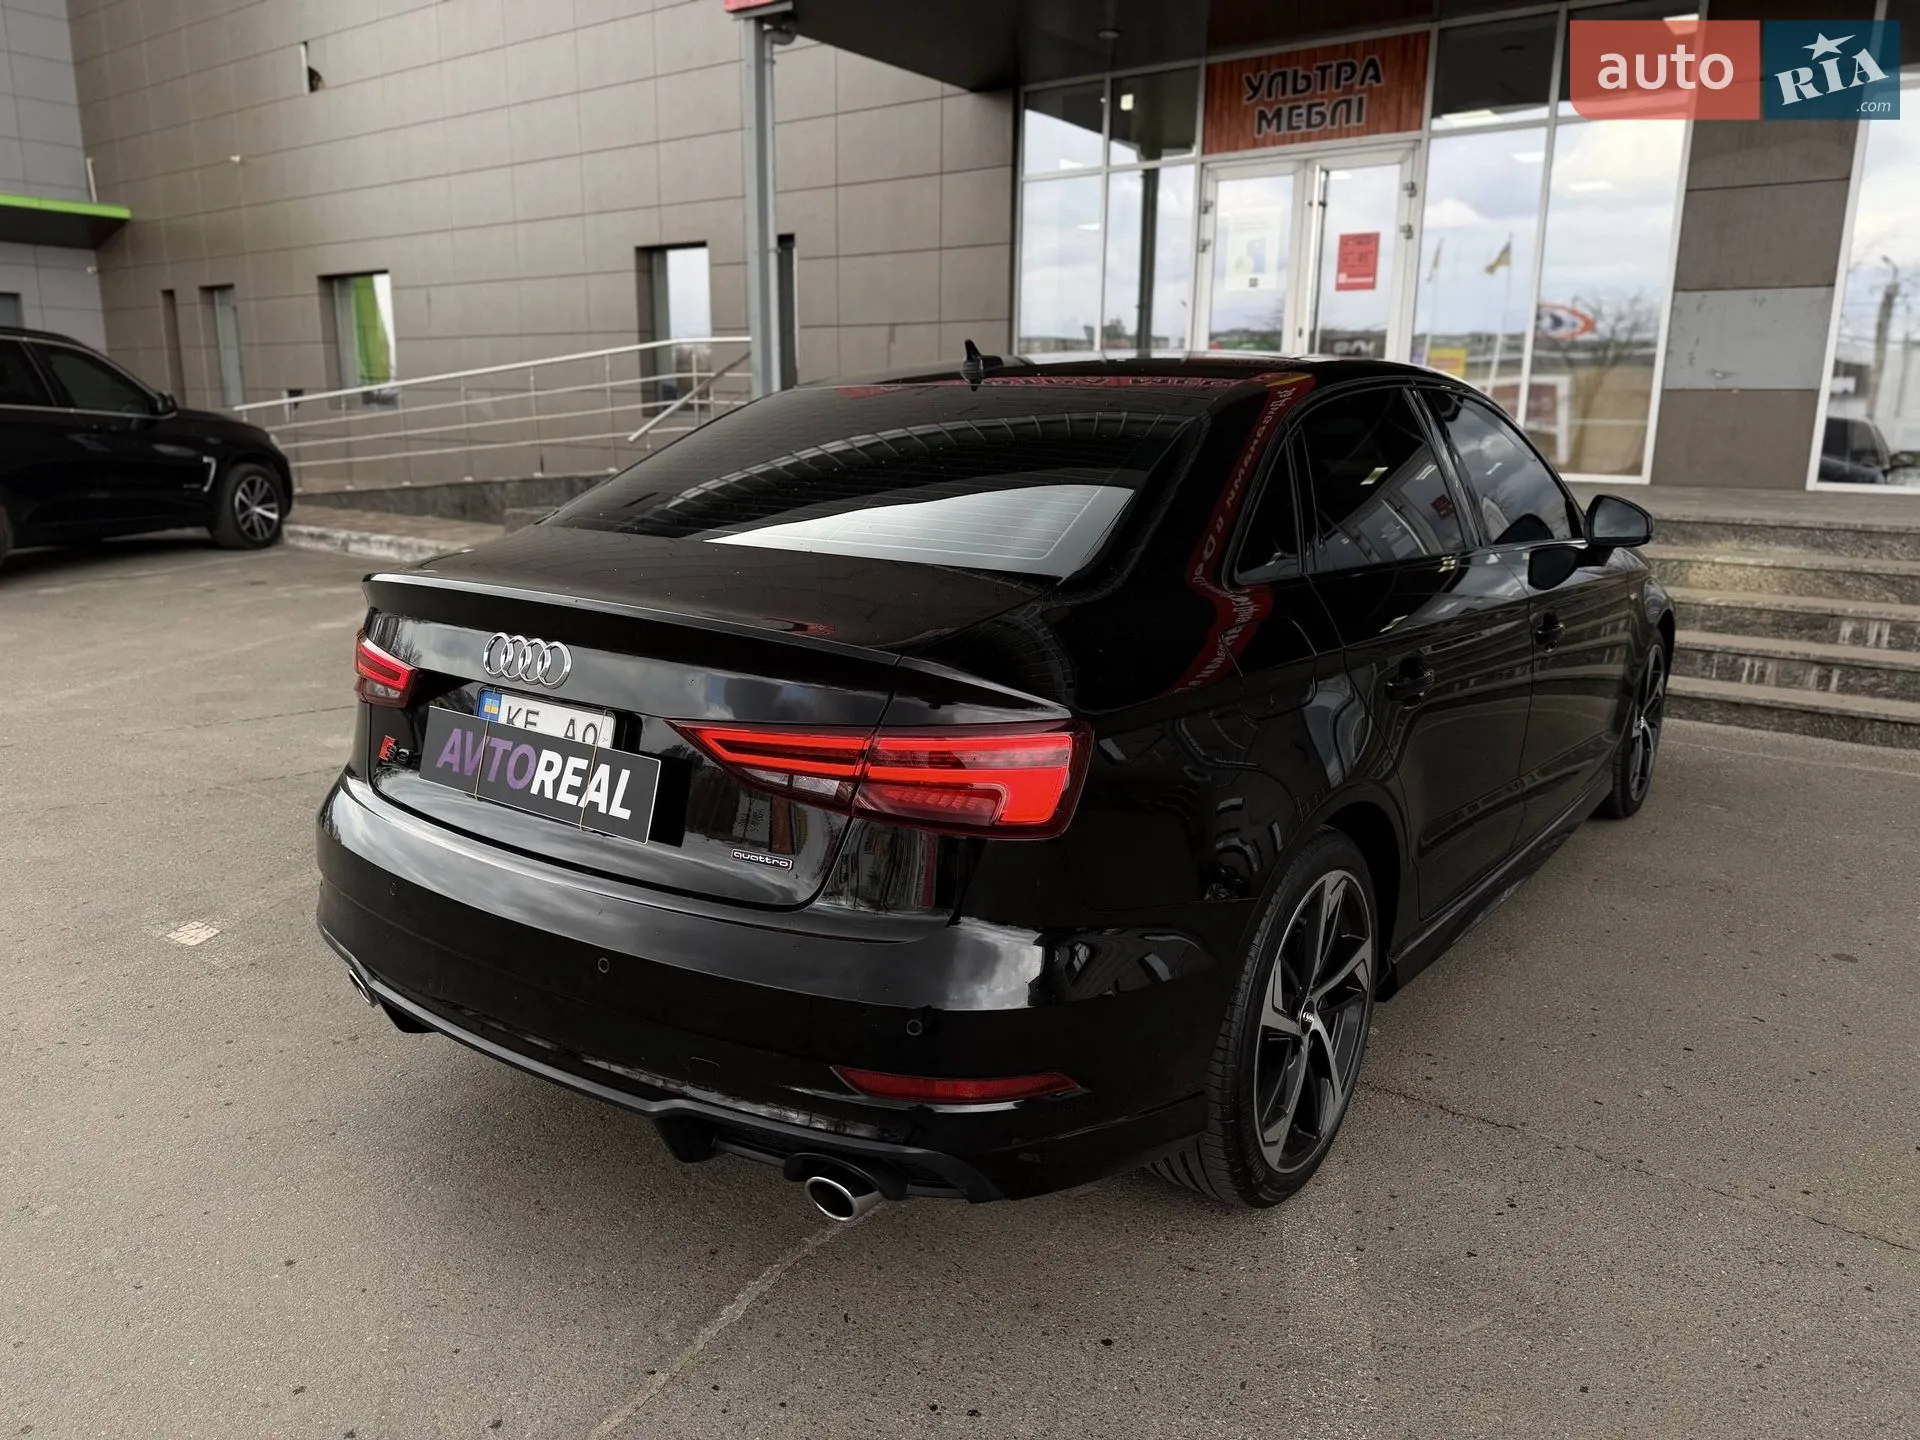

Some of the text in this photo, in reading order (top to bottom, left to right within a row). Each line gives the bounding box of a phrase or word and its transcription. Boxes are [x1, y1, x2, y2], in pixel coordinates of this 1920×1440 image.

[1243, 55, 1384, 104] УЛЬТРА
[1254, 93, 1367, 138] МЕБЛІ
[435, 727, 632, 820] AVTOREAL
[733, 850, 789, 868] quattro
